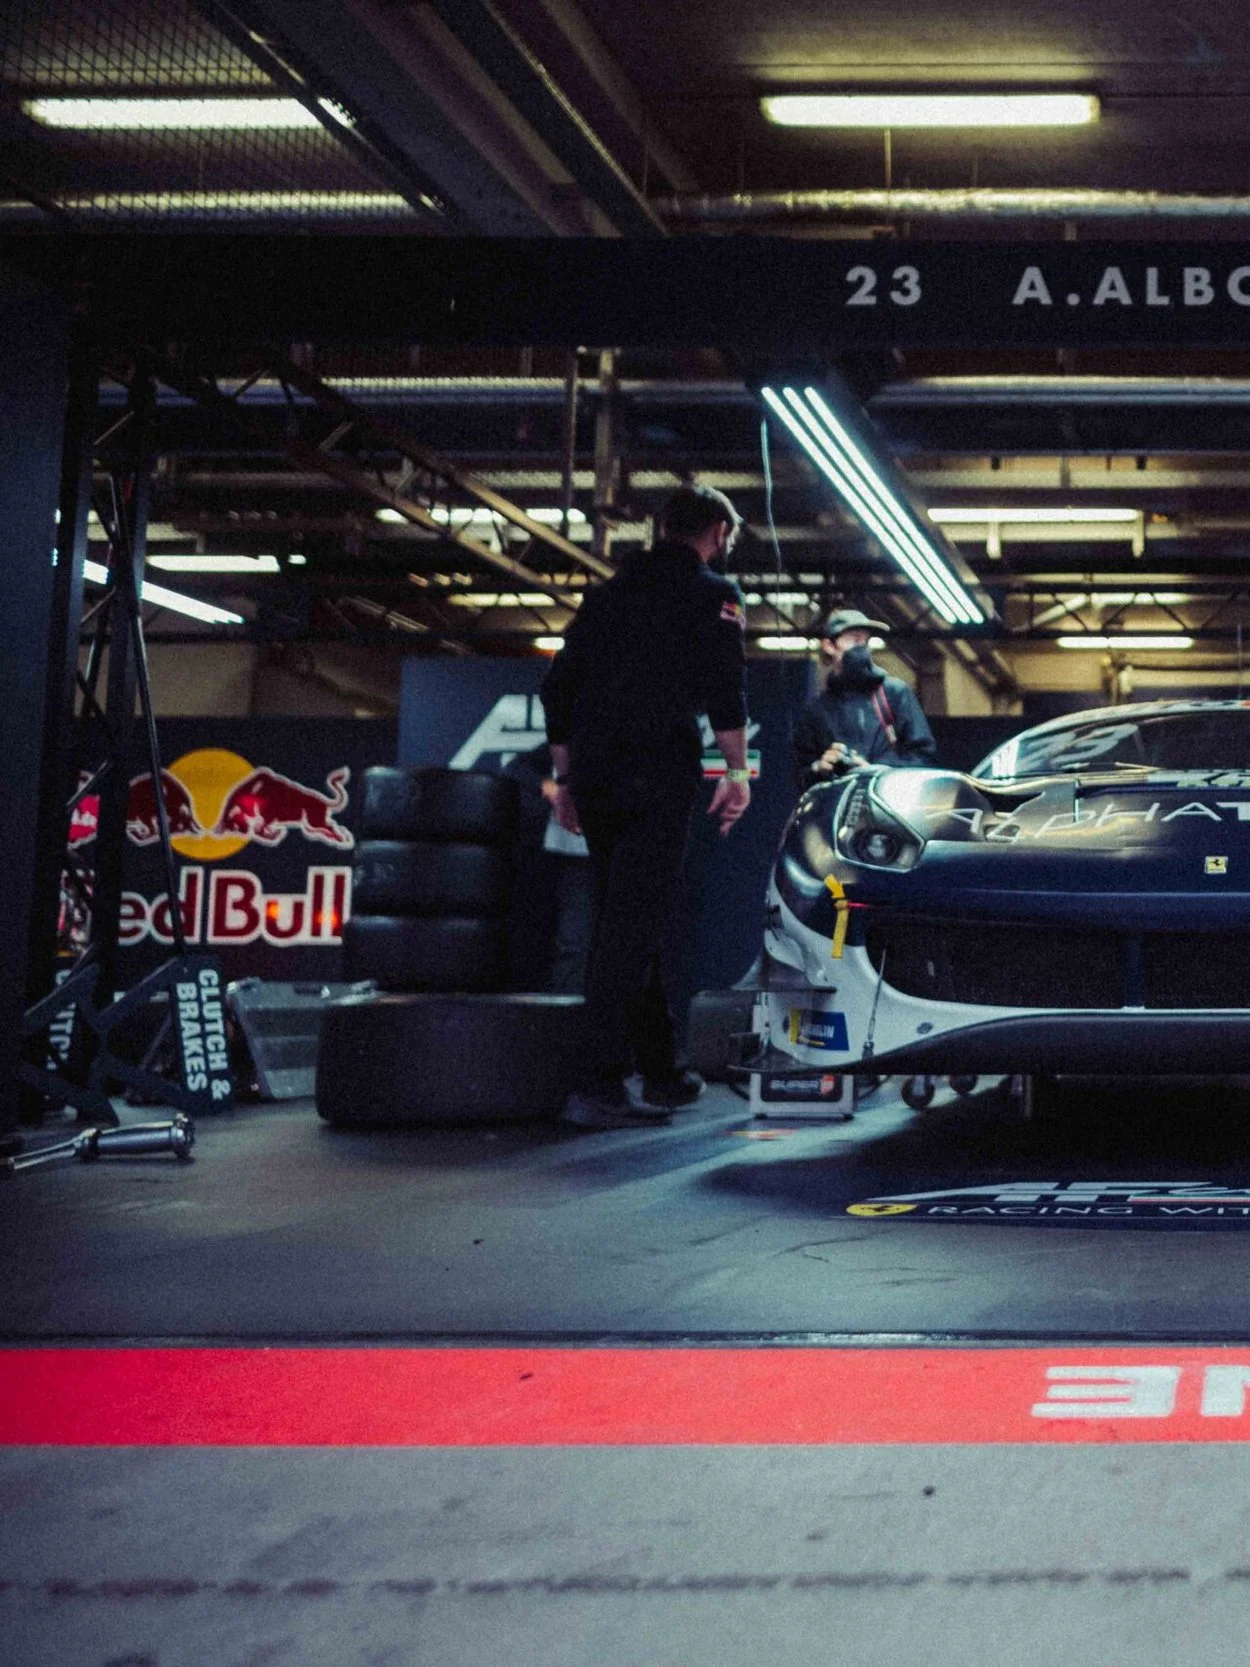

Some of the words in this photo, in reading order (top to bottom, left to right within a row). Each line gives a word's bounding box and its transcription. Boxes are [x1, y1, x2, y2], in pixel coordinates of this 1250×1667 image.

[845, 265, 923, 306] 23
[118, 865, 205, 946] ed
[206, 864, 352, 946] Bull
[176, 982, 208, 1092] BRAKES
[199, 969, 229, 1071] CLUTCH
[211, 1078, 232, 1100] &
[927, 1206, 1134, 1215] RACING
